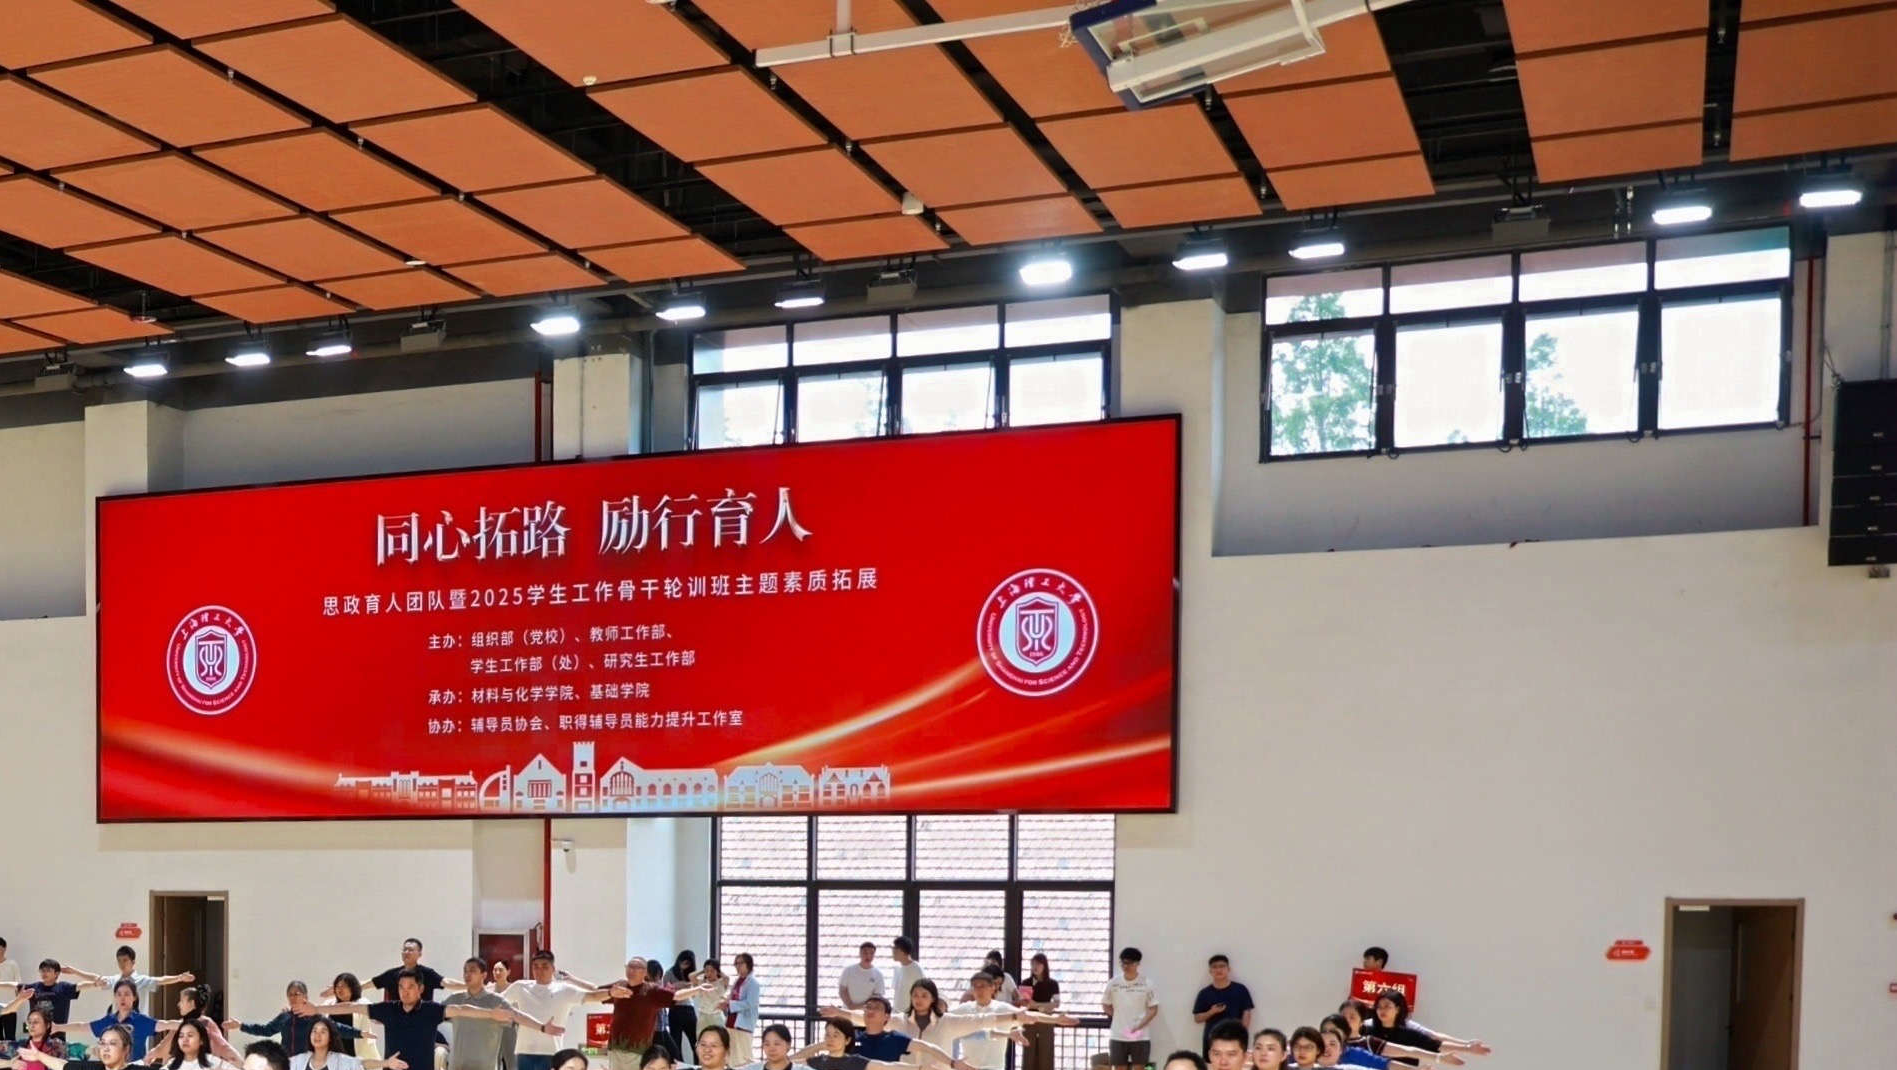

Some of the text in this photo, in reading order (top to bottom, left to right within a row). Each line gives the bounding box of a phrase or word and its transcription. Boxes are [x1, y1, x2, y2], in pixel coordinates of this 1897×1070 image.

[376, 486, 813, 567] 同心拓路 励行育人
[323, 567, 878, 616] 思政育人团队暨2025学生工作骨干轮训班主题素质拓展
